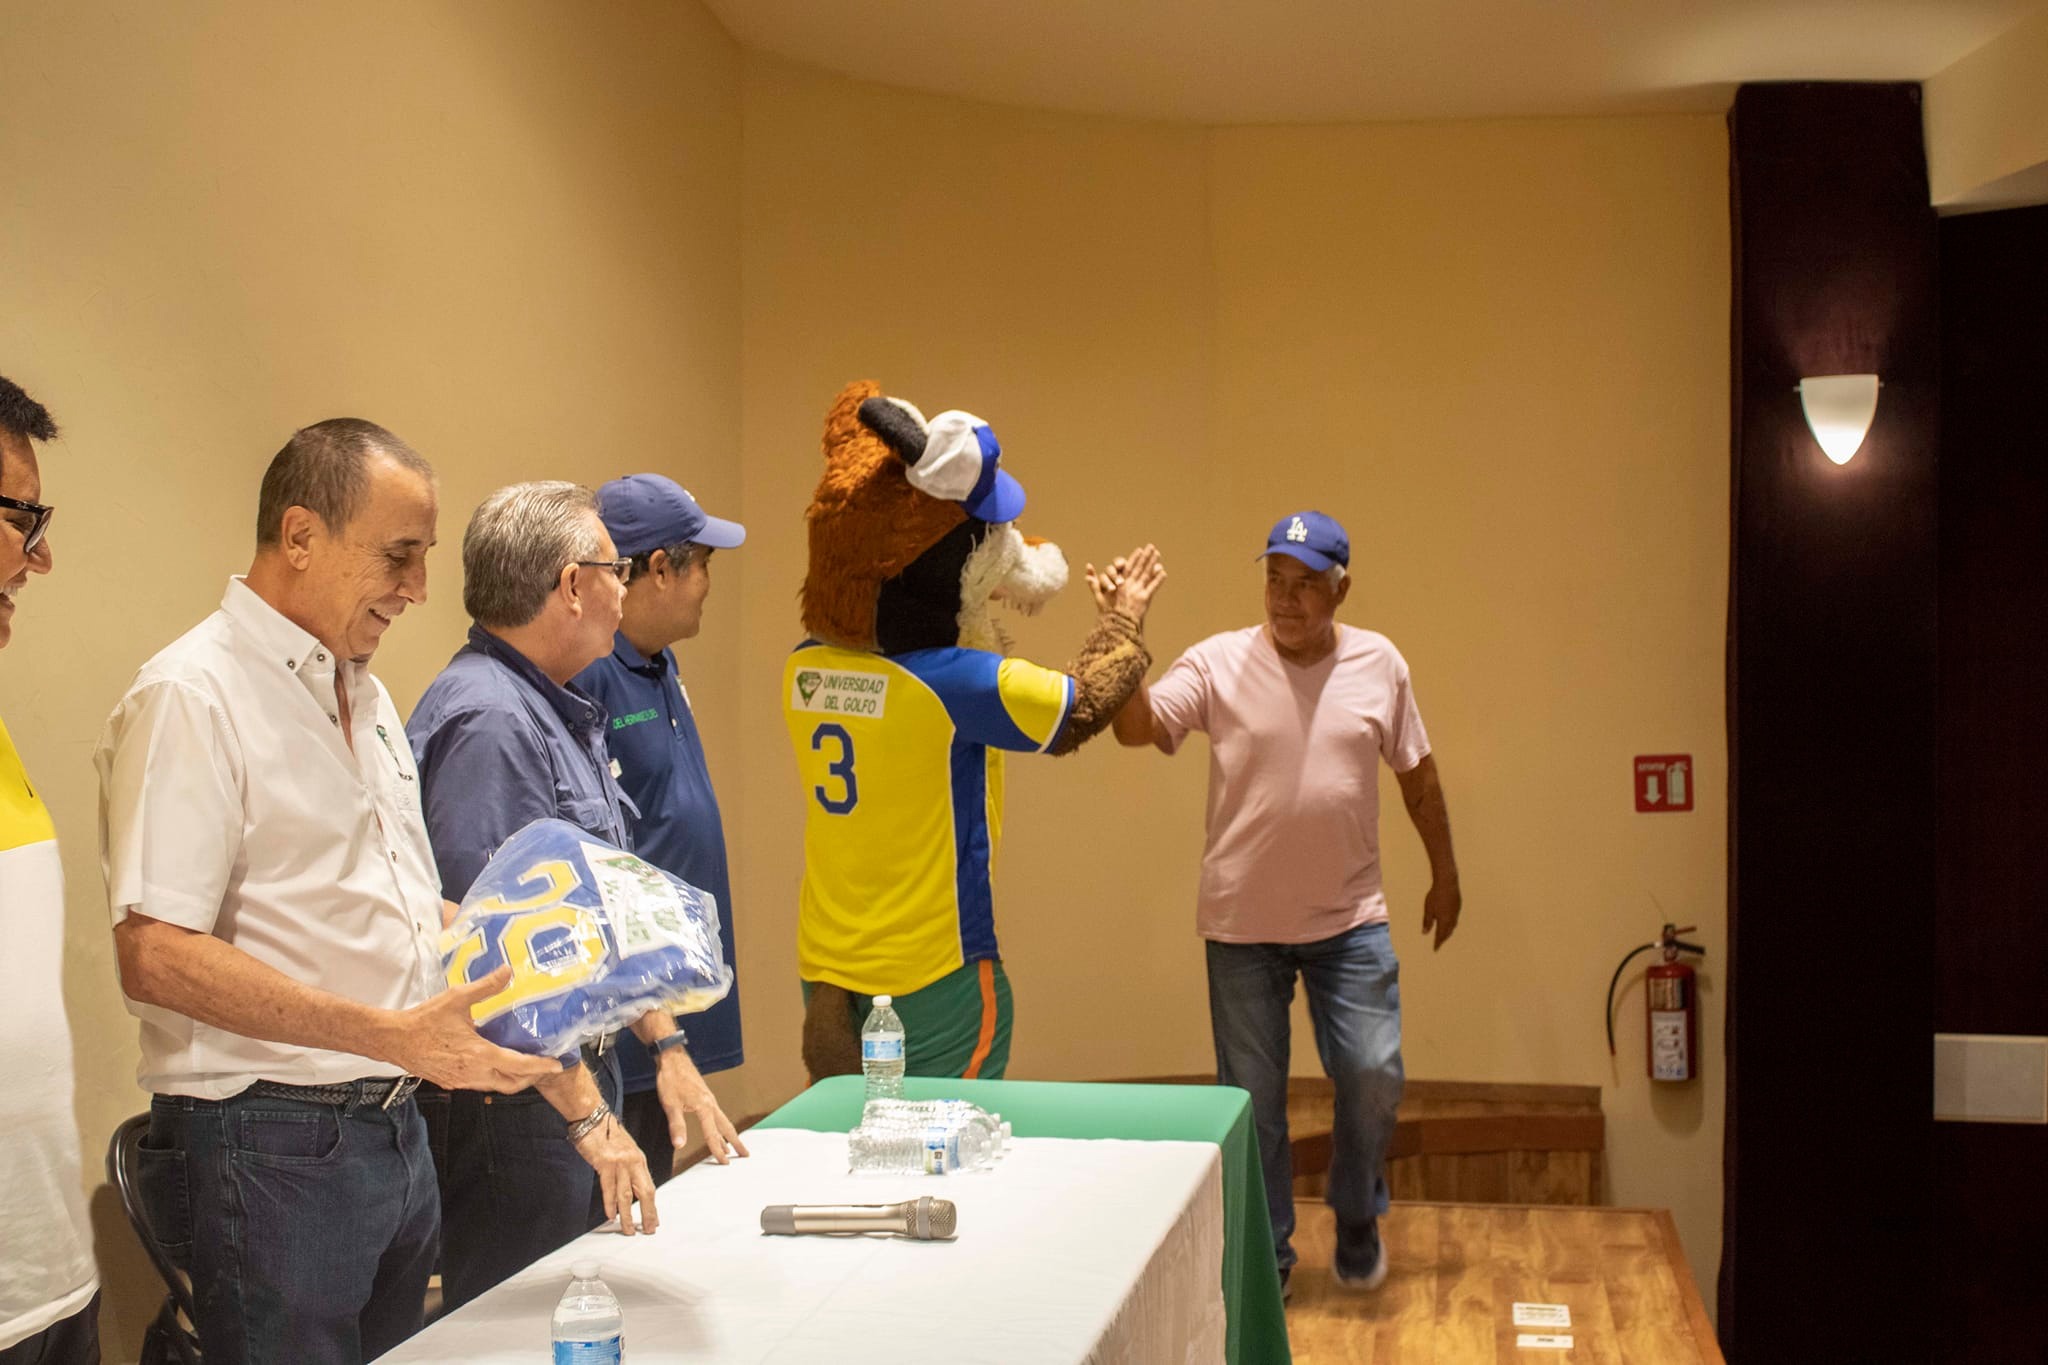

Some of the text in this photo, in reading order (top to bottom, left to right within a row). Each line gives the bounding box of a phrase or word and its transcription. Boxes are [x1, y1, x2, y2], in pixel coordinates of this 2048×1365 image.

[1286, 516, 1308, 543] LA
[823, 674, 884, 695] UNIVERSIDAD
[824, 695, 877, 715] DEL GOLFO
[811, 722, 859, 816] 3
